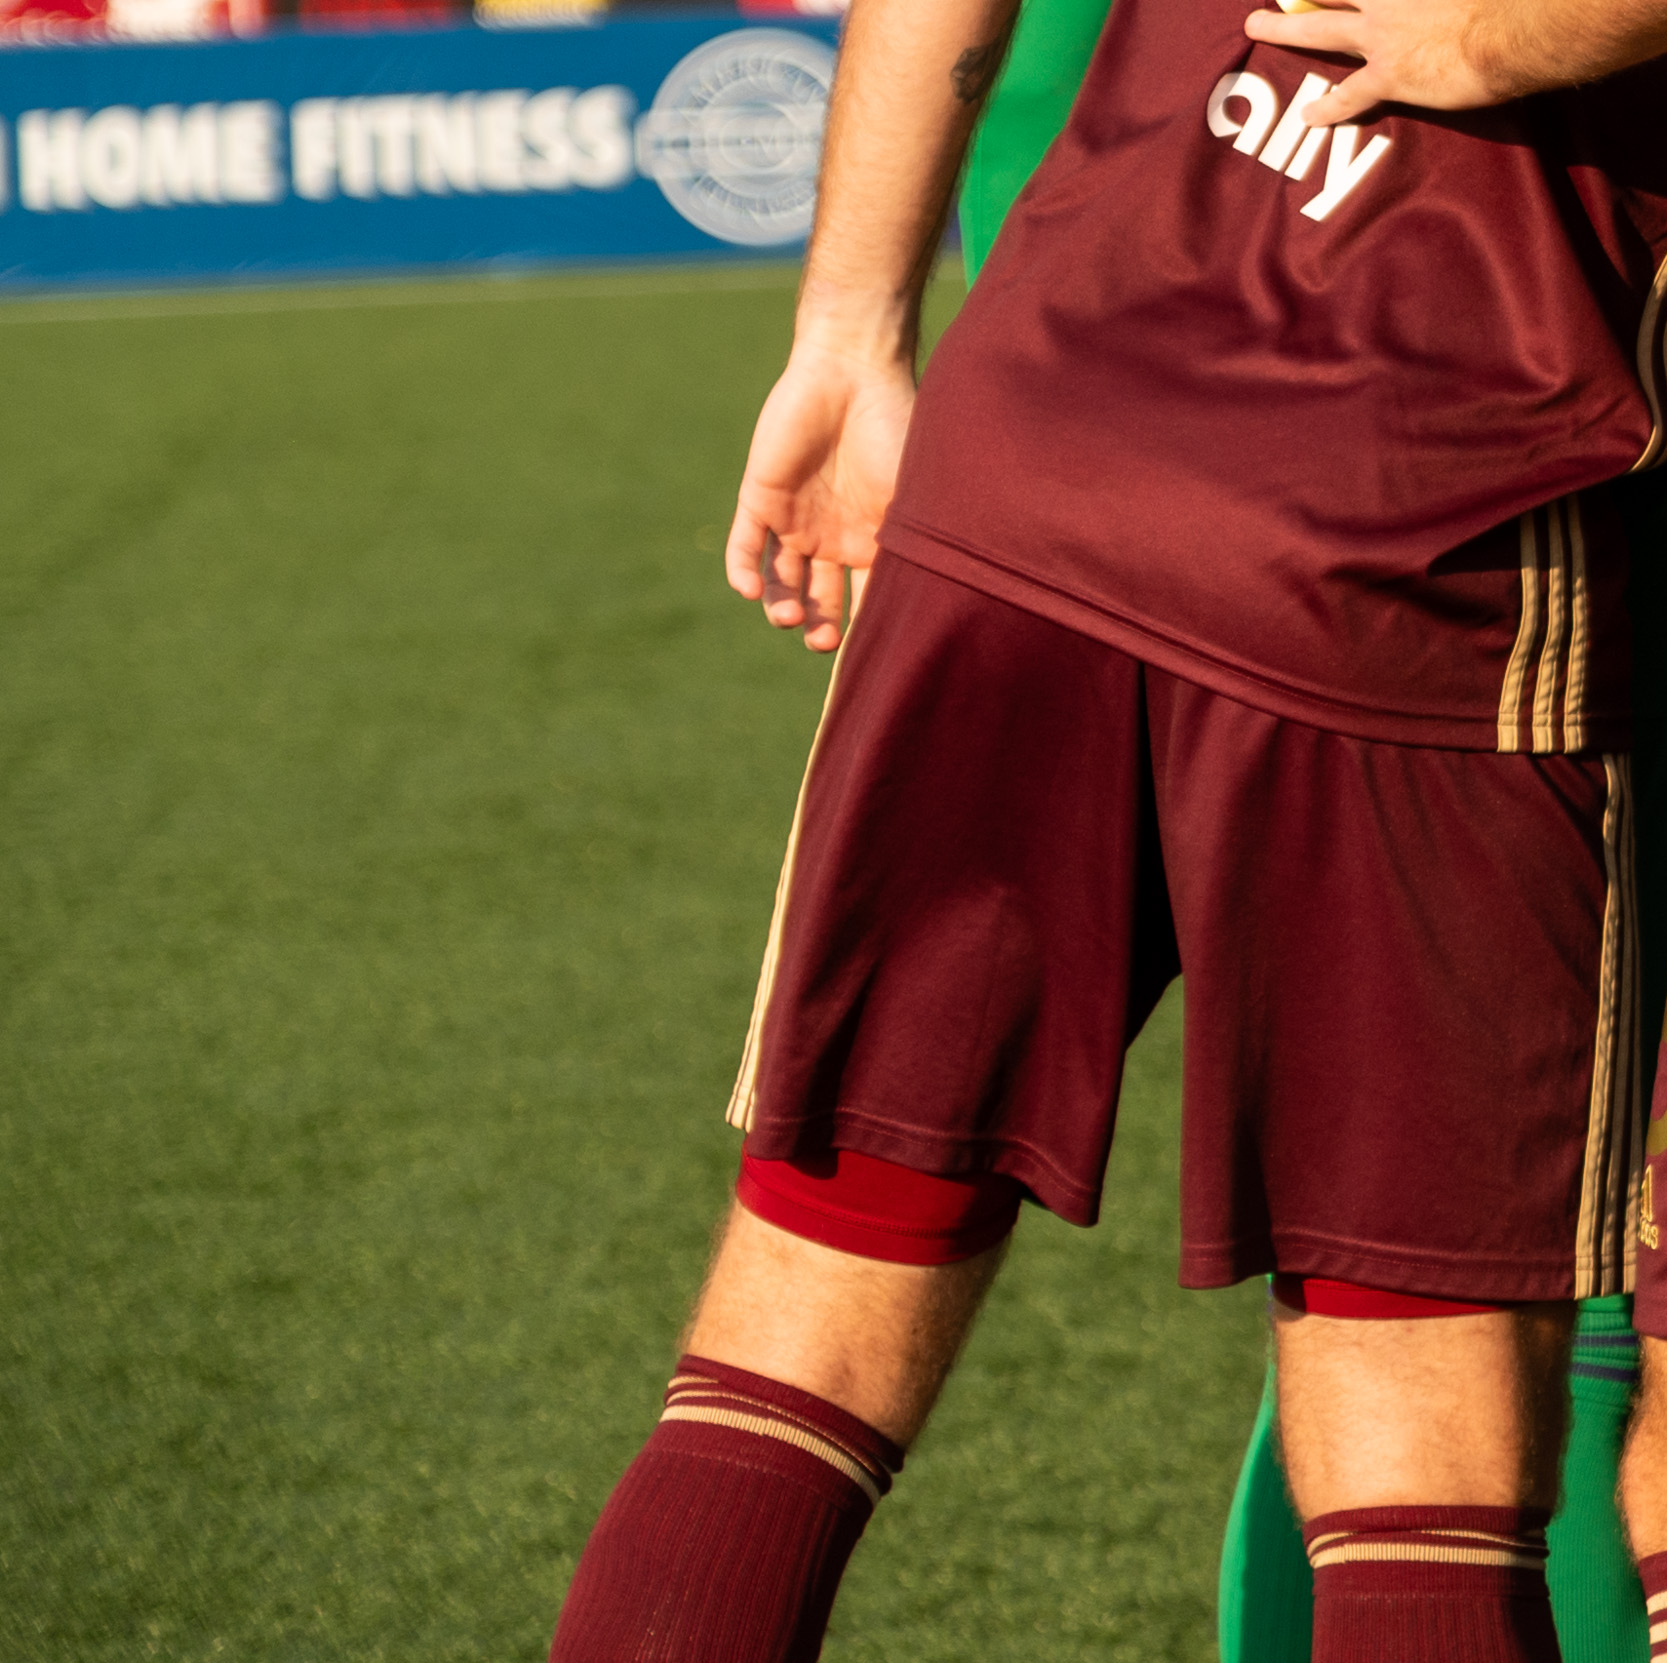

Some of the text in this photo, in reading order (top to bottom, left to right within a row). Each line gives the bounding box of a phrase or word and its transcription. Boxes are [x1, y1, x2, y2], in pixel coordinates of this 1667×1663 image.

[17, 102, 281, 211] HOME
[292, 87, 635, 200] FITNESS
[1206, 71, 1393, 222] ally
